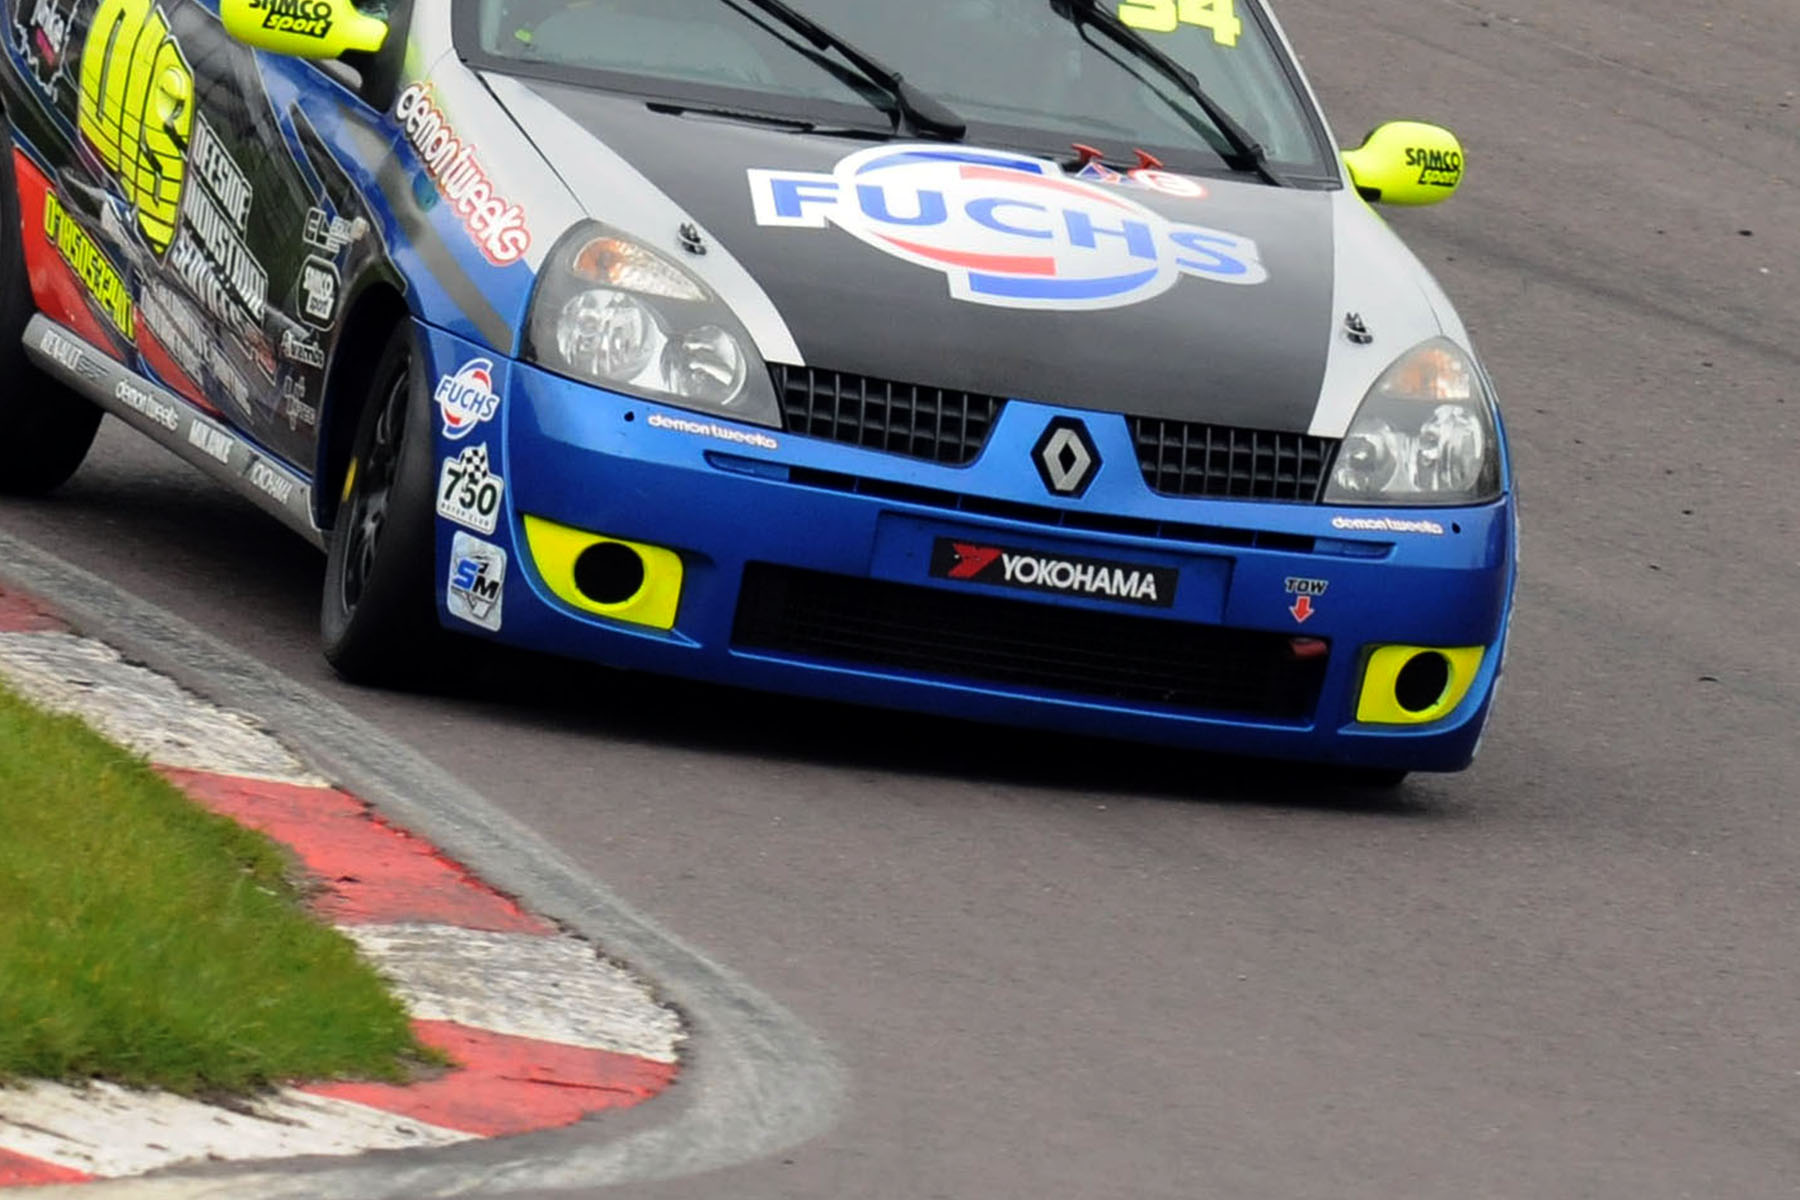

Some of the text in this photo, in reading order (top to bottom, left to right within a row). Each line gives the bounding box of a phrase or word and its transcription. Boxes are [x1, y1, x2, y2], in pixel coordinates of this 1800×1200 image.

[263, 12, 332, 38] sport
[192, 118, 253, 234] DEESIDE
[1405, 147, 1460, 170] SAMCO
[184, 173, 267, 320] INDUSTRIAL
[770, 179, 1250, 276] FUCHS
[436, 378, 498, 418] FUCHS
[444, 468, 497, 517] 750
[1001, 553, 1157, 600] YOKOHAMA
[1284, 577, 1328, 596] TOW
